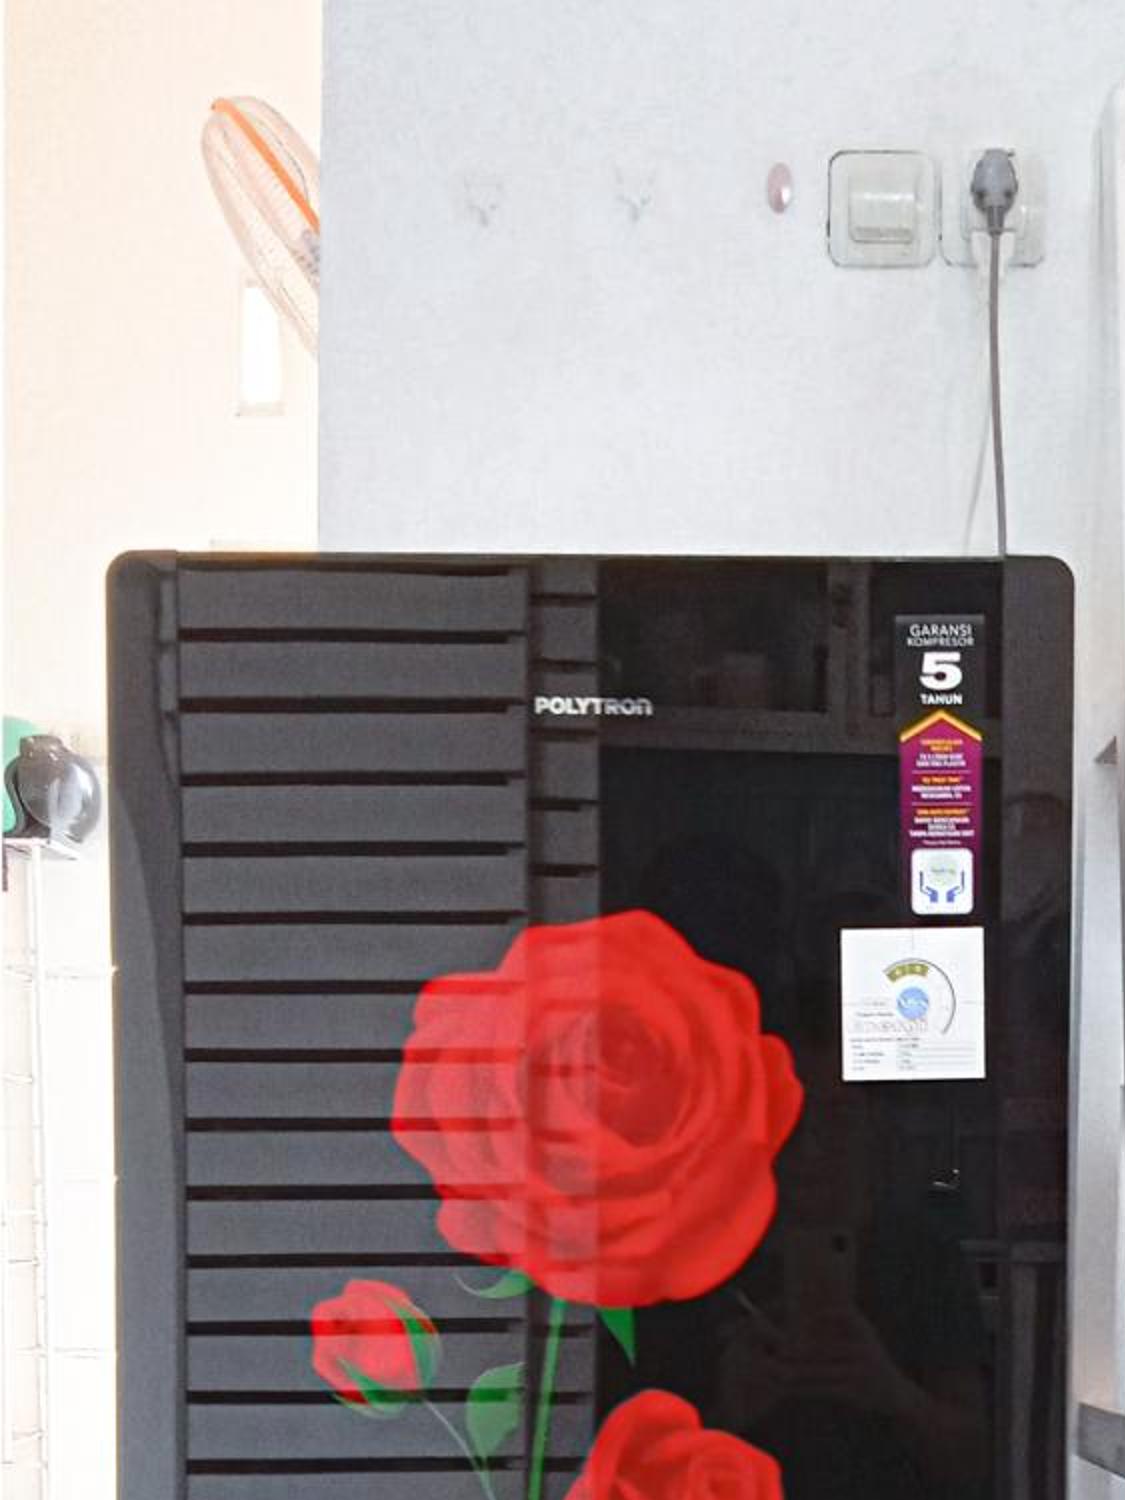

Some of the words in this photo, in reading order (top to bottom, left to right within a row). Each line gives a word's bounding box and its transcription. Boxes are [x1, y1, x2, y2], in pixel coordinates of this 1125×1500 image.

[909, 623, 972, 637] GARANSI
[919, 651, 963, 691] 5
[534, 696, 653, 716] POLYTRON
[919, 693, 963, 705] TAHUN
